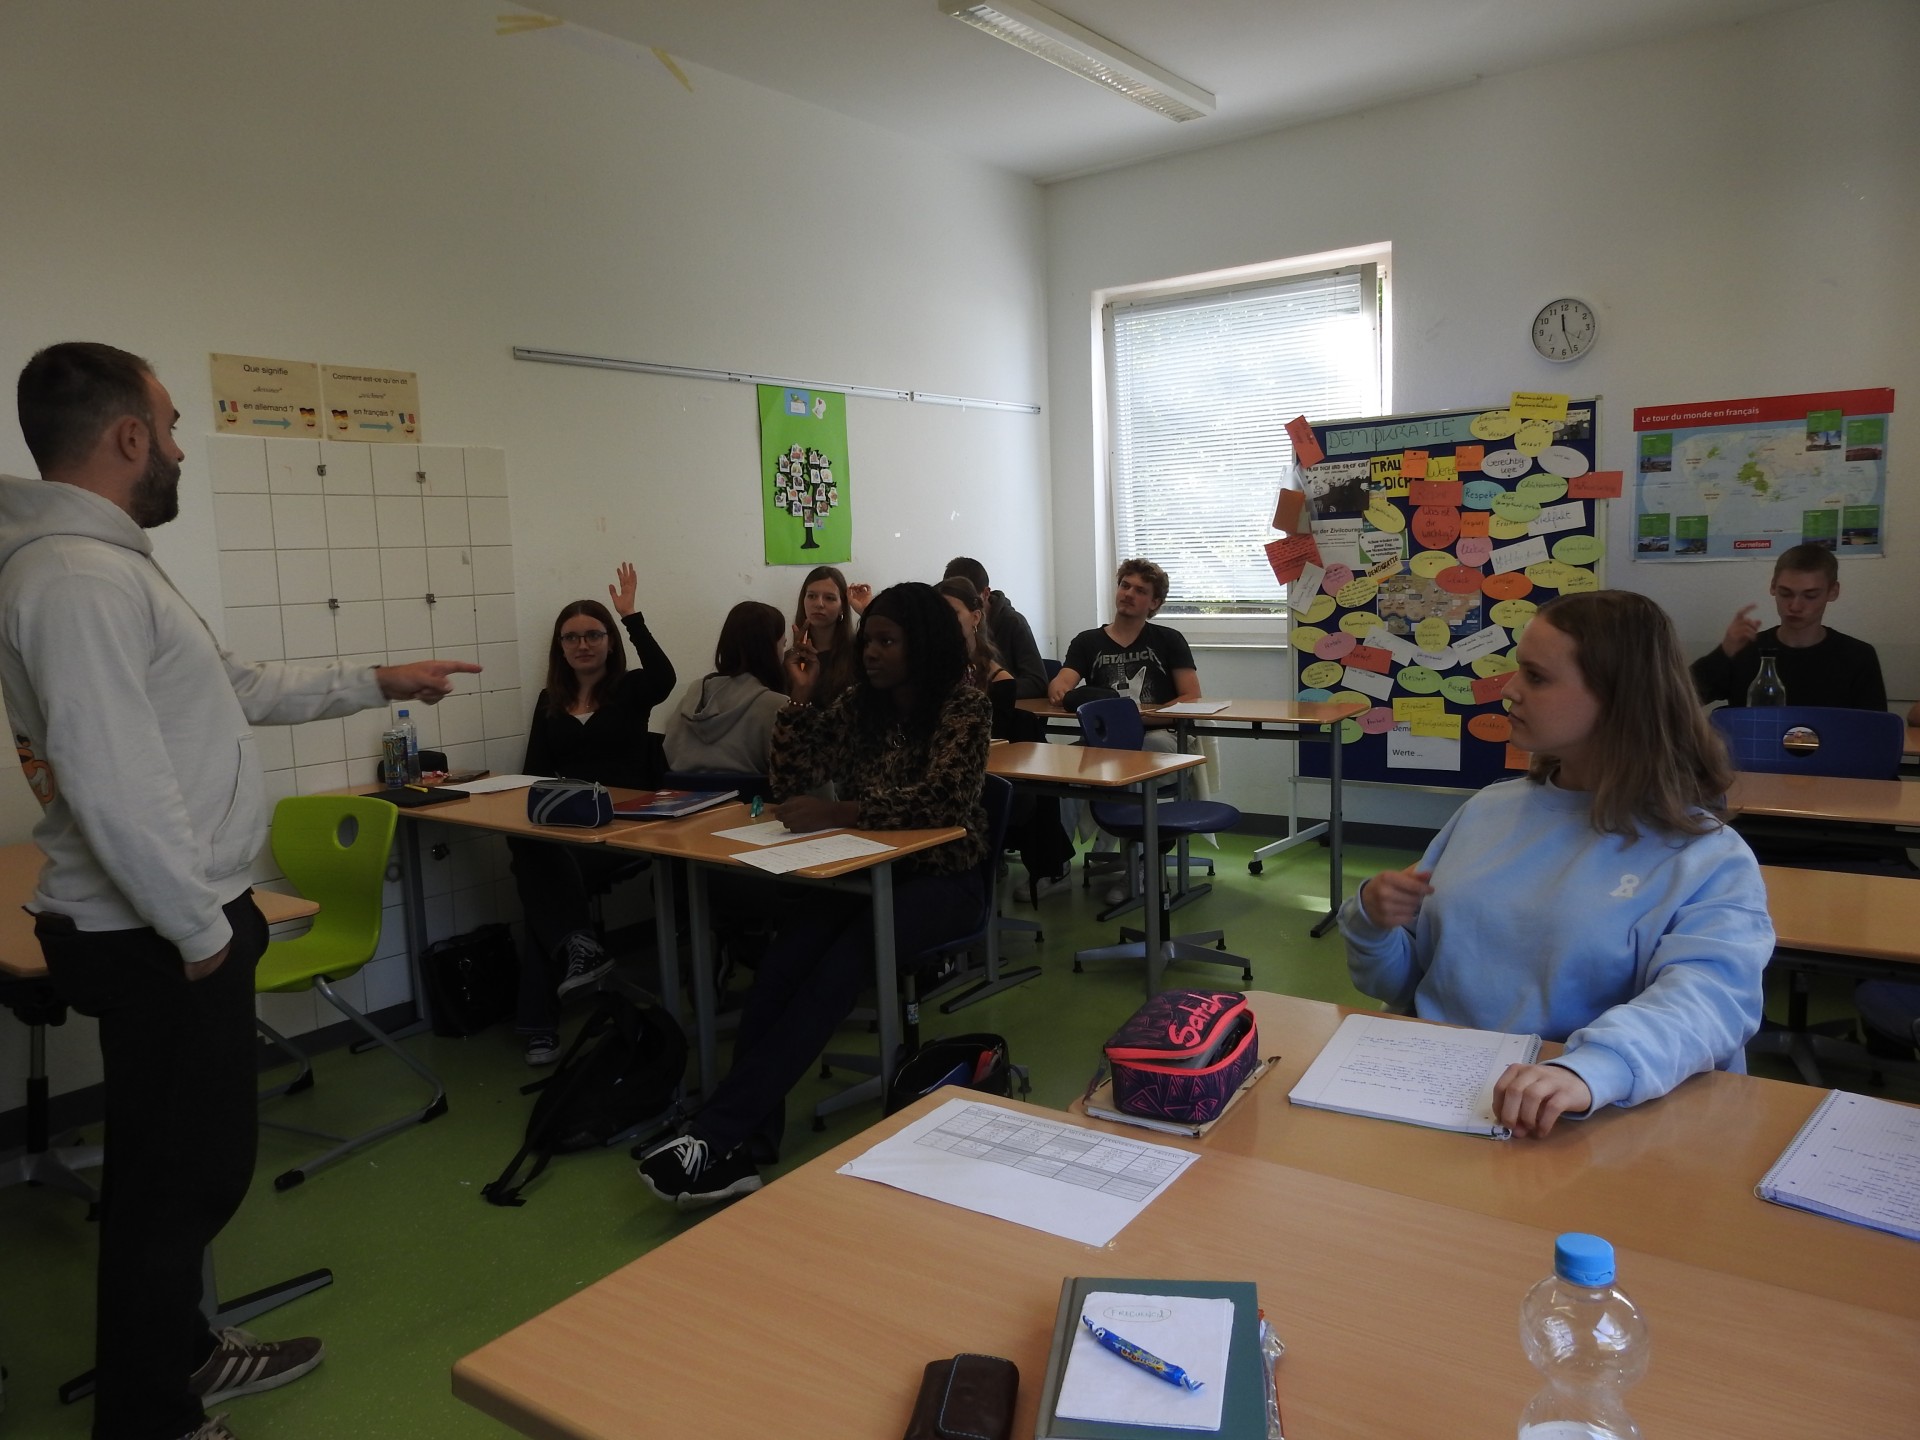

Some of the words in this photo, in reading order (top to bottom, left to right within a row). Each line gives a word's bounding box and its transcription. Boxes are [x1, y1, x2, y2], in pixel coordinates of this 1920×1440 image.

[244, 365, 259, 373] Que
[262, 367, 288, 375] signifie
[332, 373, 361, 381] Comment
[255, 403, 288, 412] allemand
[363, 409, 388, 417] français
[1671, 412, 1681, 421] du
[1683, 411, 1712, 419] monde
[1726, 406, 1760, 417] français
[1328, 420, 1455, 449] DEMOKRATIE
[1371, 460, 1401, 473] TRAU
[1090, 646, 1167, 680] METALLICA
[1392, 749, 1415, 757] Werte
